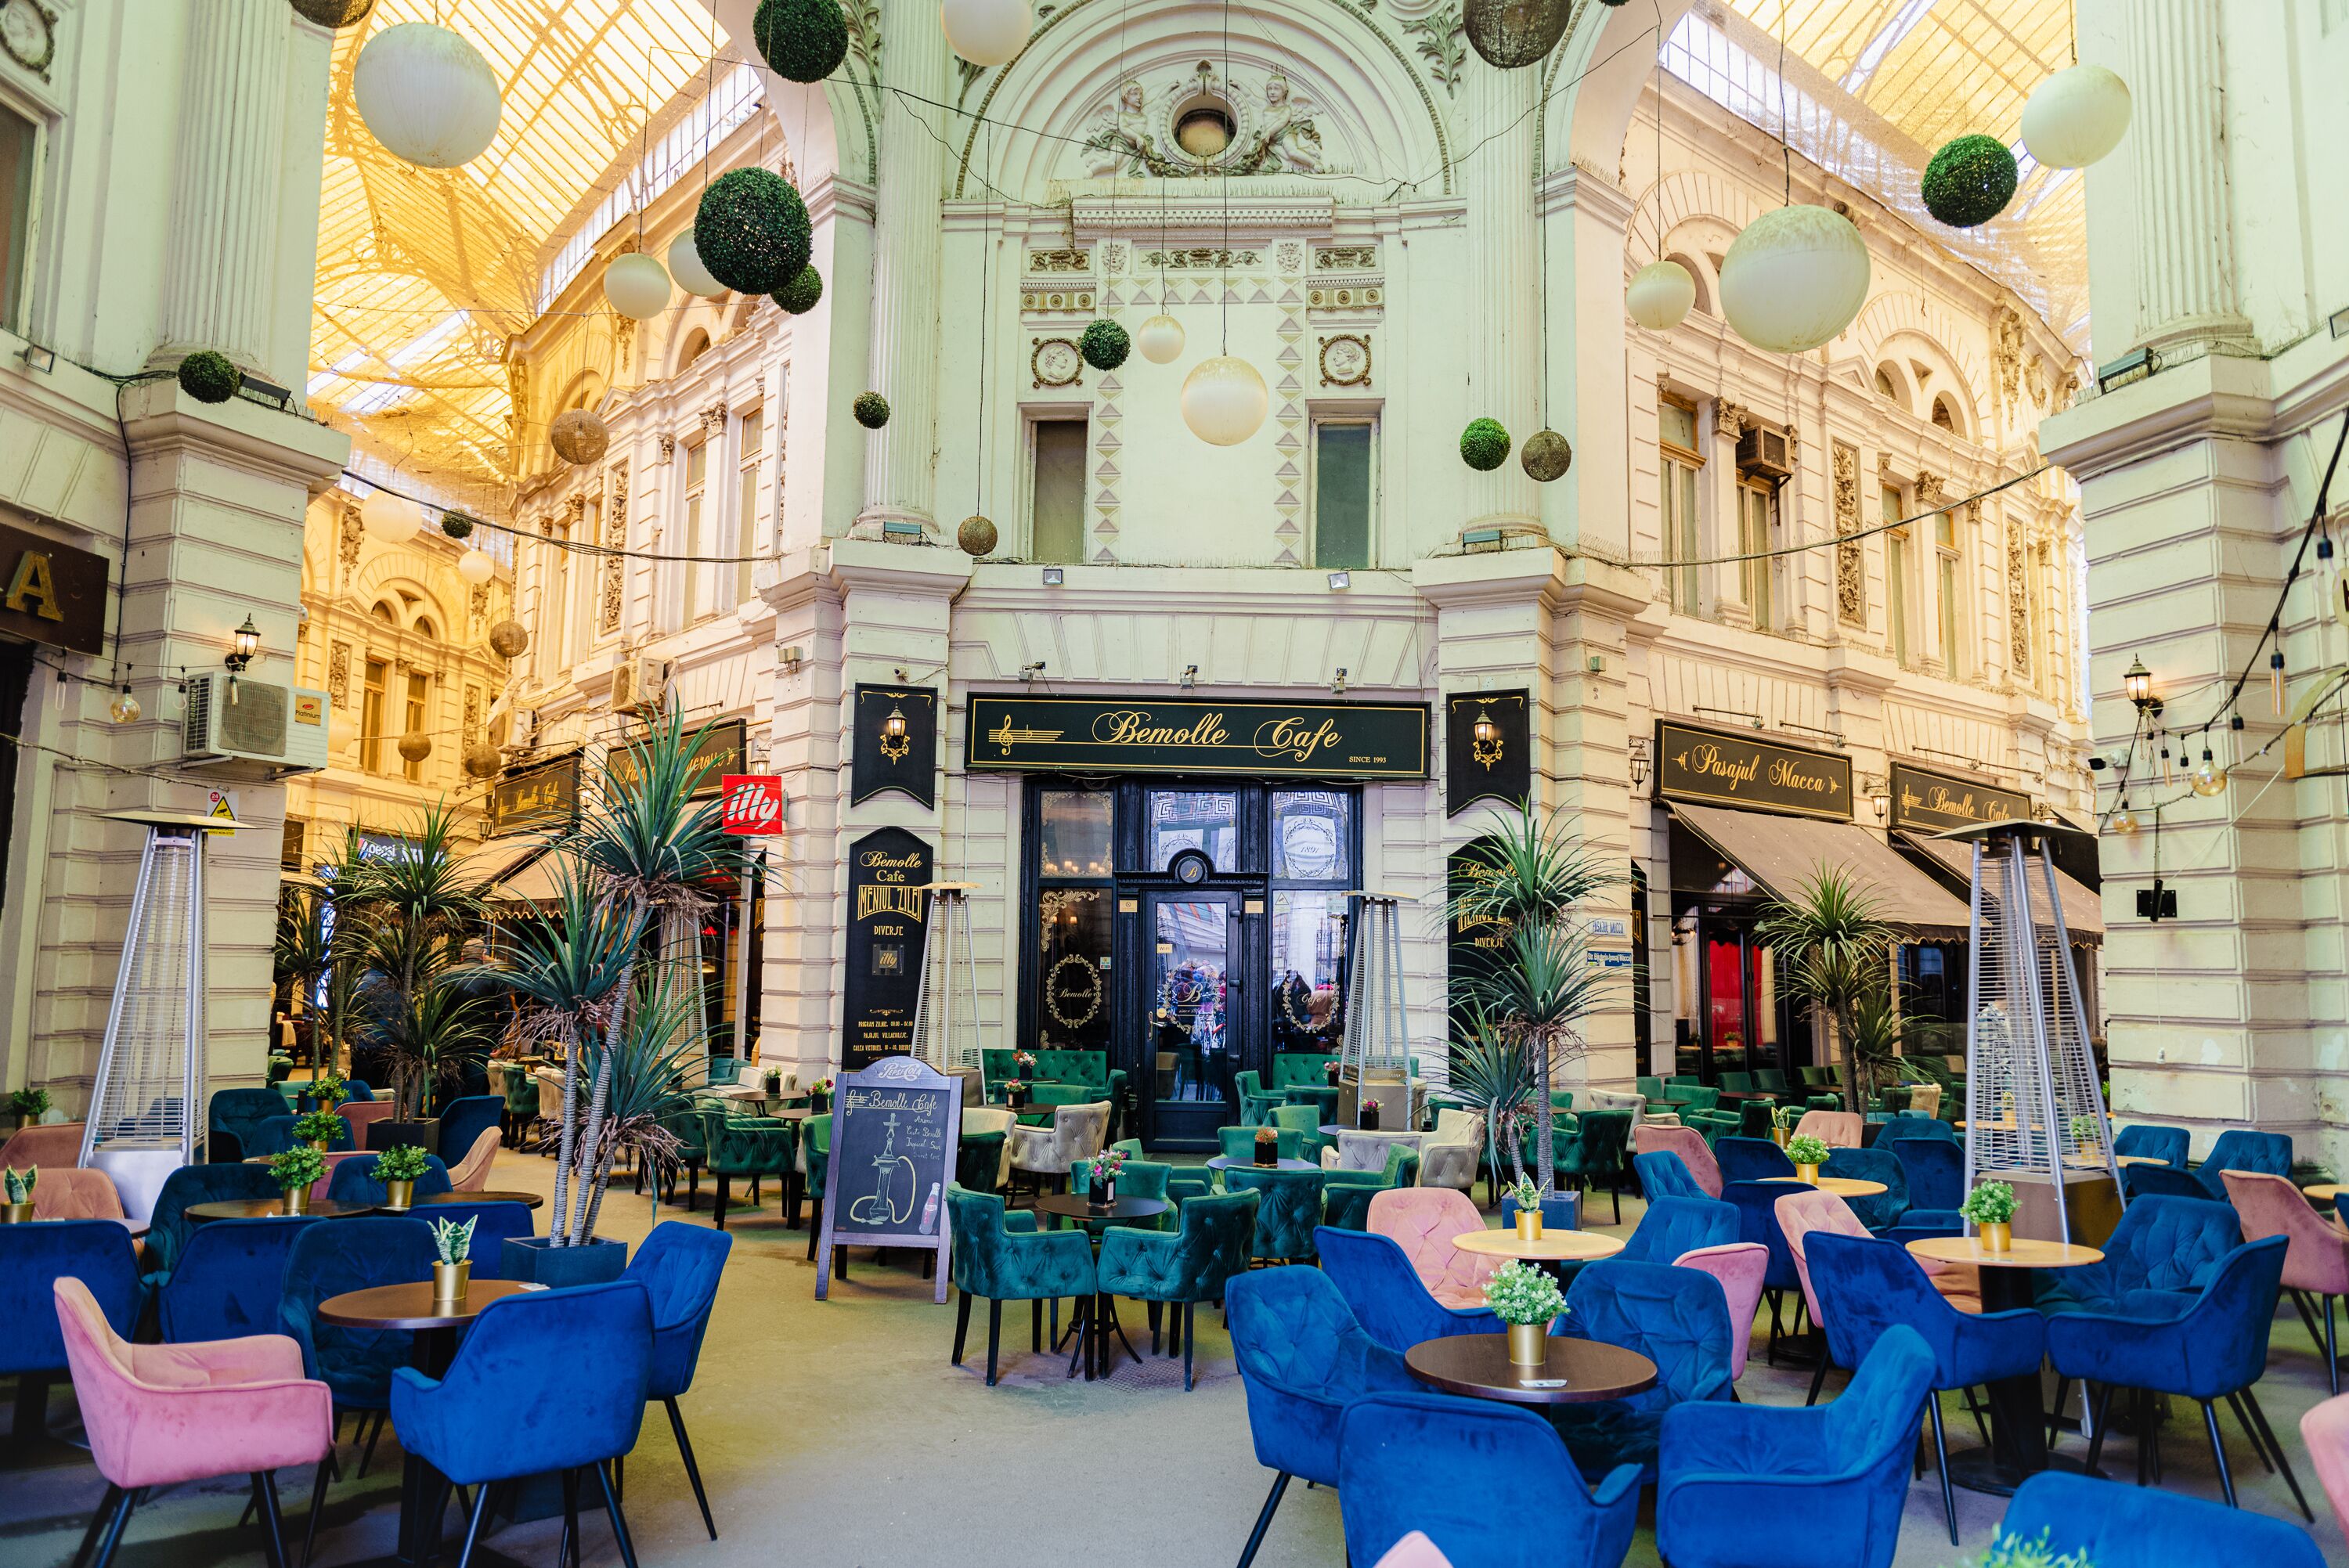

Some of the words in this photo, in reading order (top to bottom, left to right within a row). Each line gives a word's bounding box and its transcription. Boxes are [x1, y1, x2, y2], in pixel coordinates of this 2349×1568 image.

[6, 550, 64, 622] A
[1092, 710, 1230, 745] Bemolle
[1254, 716, 1342, 762] Cafe
[1691, 744, 1760, 791] Pasajul
[1768, 758, 1825, 792] Macca
[727, 783, 780, 830] illy
[1928, 785, 1976, 818] Bemolle
[1982, 800, 2011, 822] Cafe
[861, 851, 922, 868] Bemolle
[876, 870, 905, 882] Cafe
[1185, 864, 1199, 878] B
[860, 887, 893, 917] MENIUL
[897, 888, 921, 921] ZILEI
[874, 925, 904, 936] DIVERSE
[879, 952, 897, 968] illy
[1056, 988, 1093, 999] Bemolle
[1297, 993, 1323, 1008] Cafe
[868, 1090, 908, 1108] Bemolle
[912, 1094, 938, 1117] Cafe
